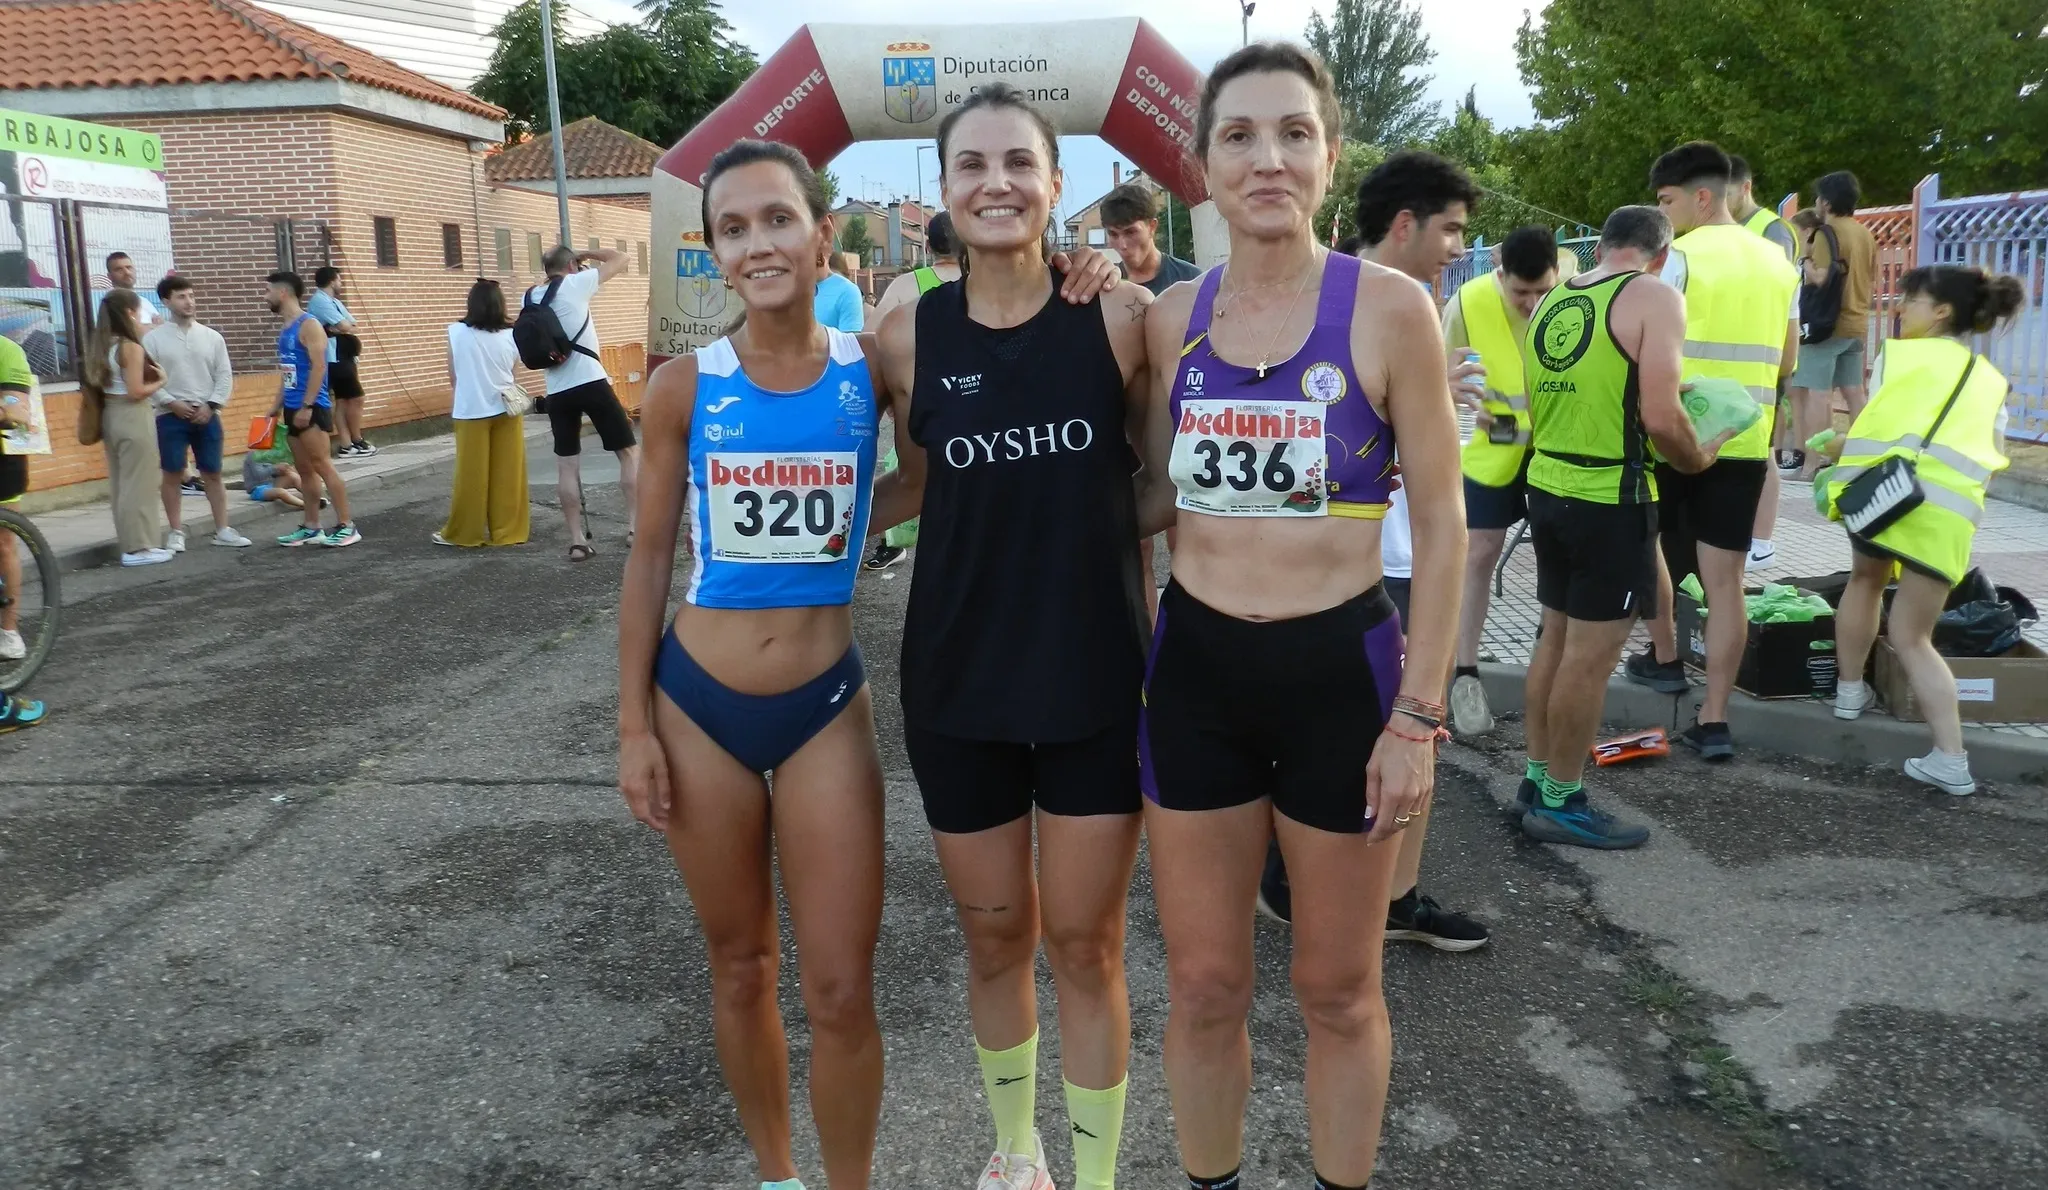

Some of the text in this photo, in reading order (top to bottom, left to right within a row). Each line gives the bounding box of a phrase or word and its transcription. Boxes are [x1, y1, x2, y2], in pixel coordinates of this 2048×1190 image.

[944, 55, 1048, 78] Diputación
[1135, 66, 1171, 98] CON
[754, 69, 825, 137] DEPORTE
[945, 91, 961, 104] de
[5, 118, 126, 158] RBAJOSA
[958, 374, 982, 384] VICKY
[960, 381, 979, 389] FOODS
[1537, 381, 1576, 393] JOSEMA
[1236, 404, 1282, 412] FLORISTERÍAS
[1179, 408, 1321, 438] bedunia
[945, 418, 1093, 469] OYSHO
[711, 459, 854, 486] bedunia
[1193, 440, 1295, 492] 336
[734, 489, 834, 537] 320
